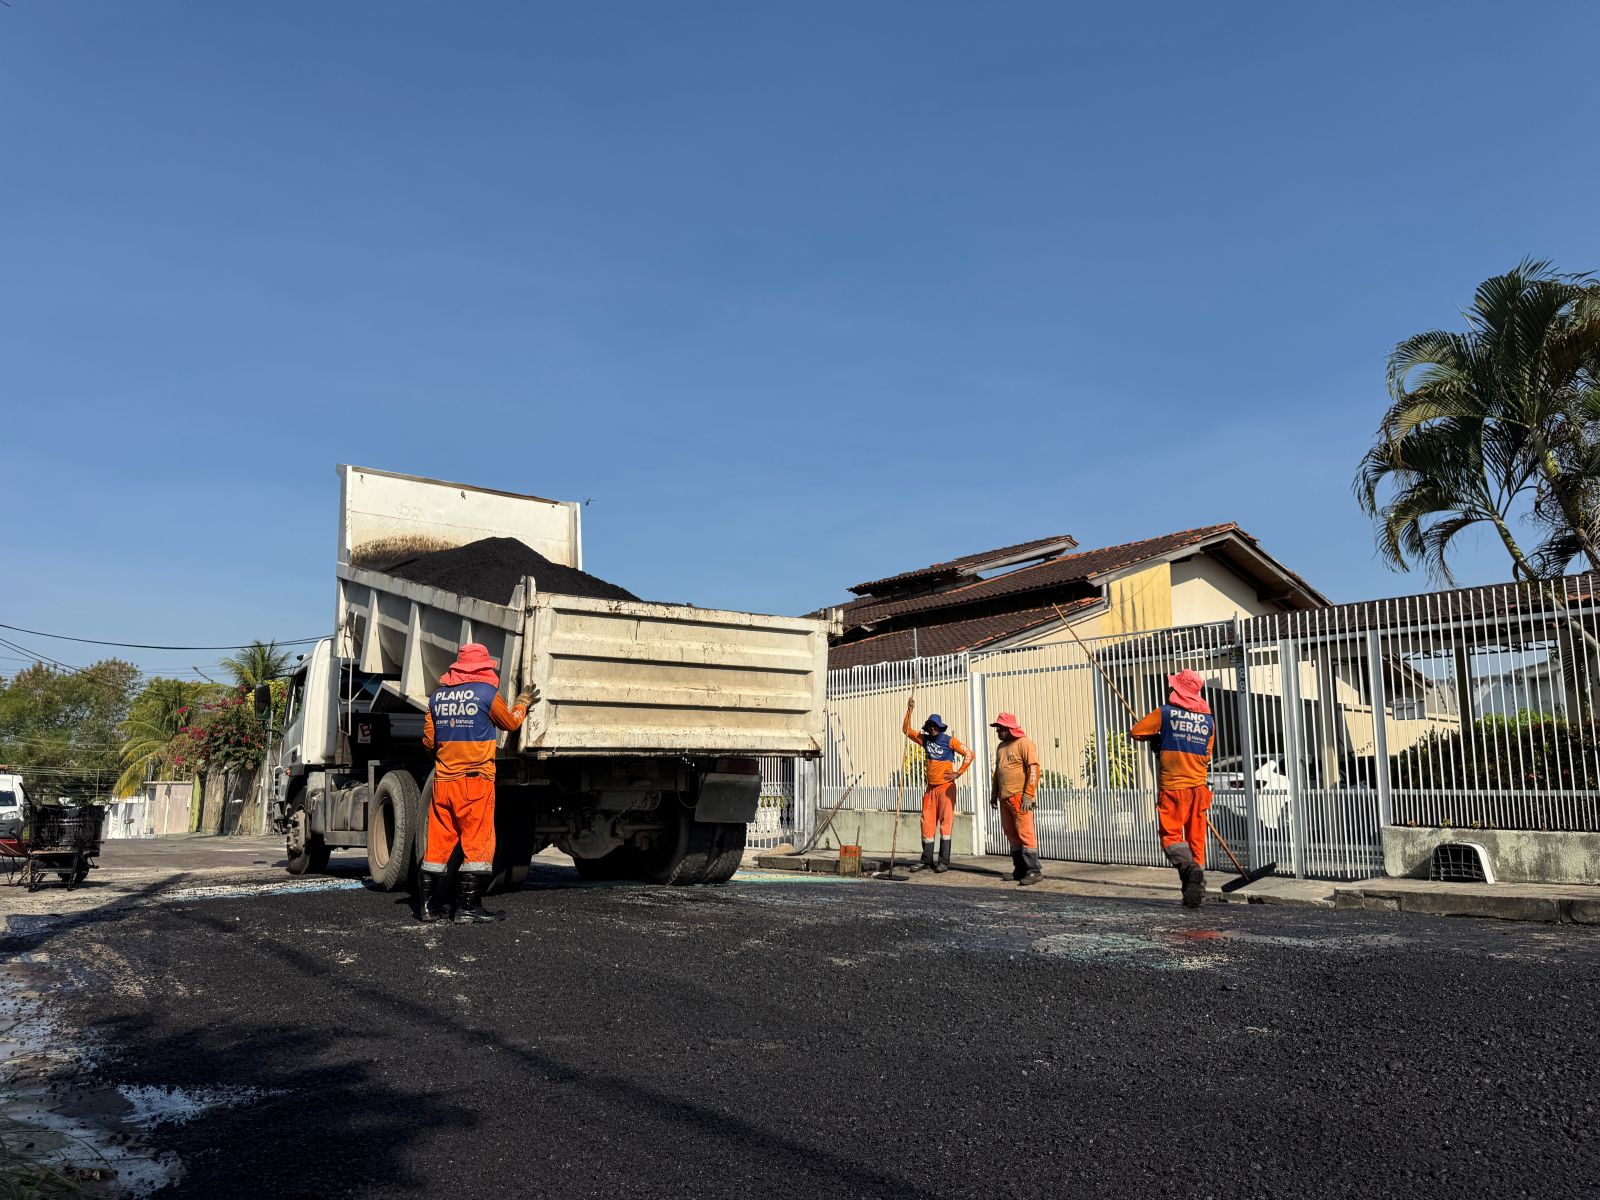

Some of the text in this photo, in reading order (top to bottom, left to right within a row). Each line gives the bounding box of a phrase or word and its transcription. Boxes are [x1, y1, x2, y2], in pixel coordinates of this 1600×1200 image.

[435, 689, 475, 702] PLANO
[434, 699, 479, 717] VERÃO
[1170, 709, 1206, 723] PLANO
[1170, 719, 1209, 736] VERÃO
